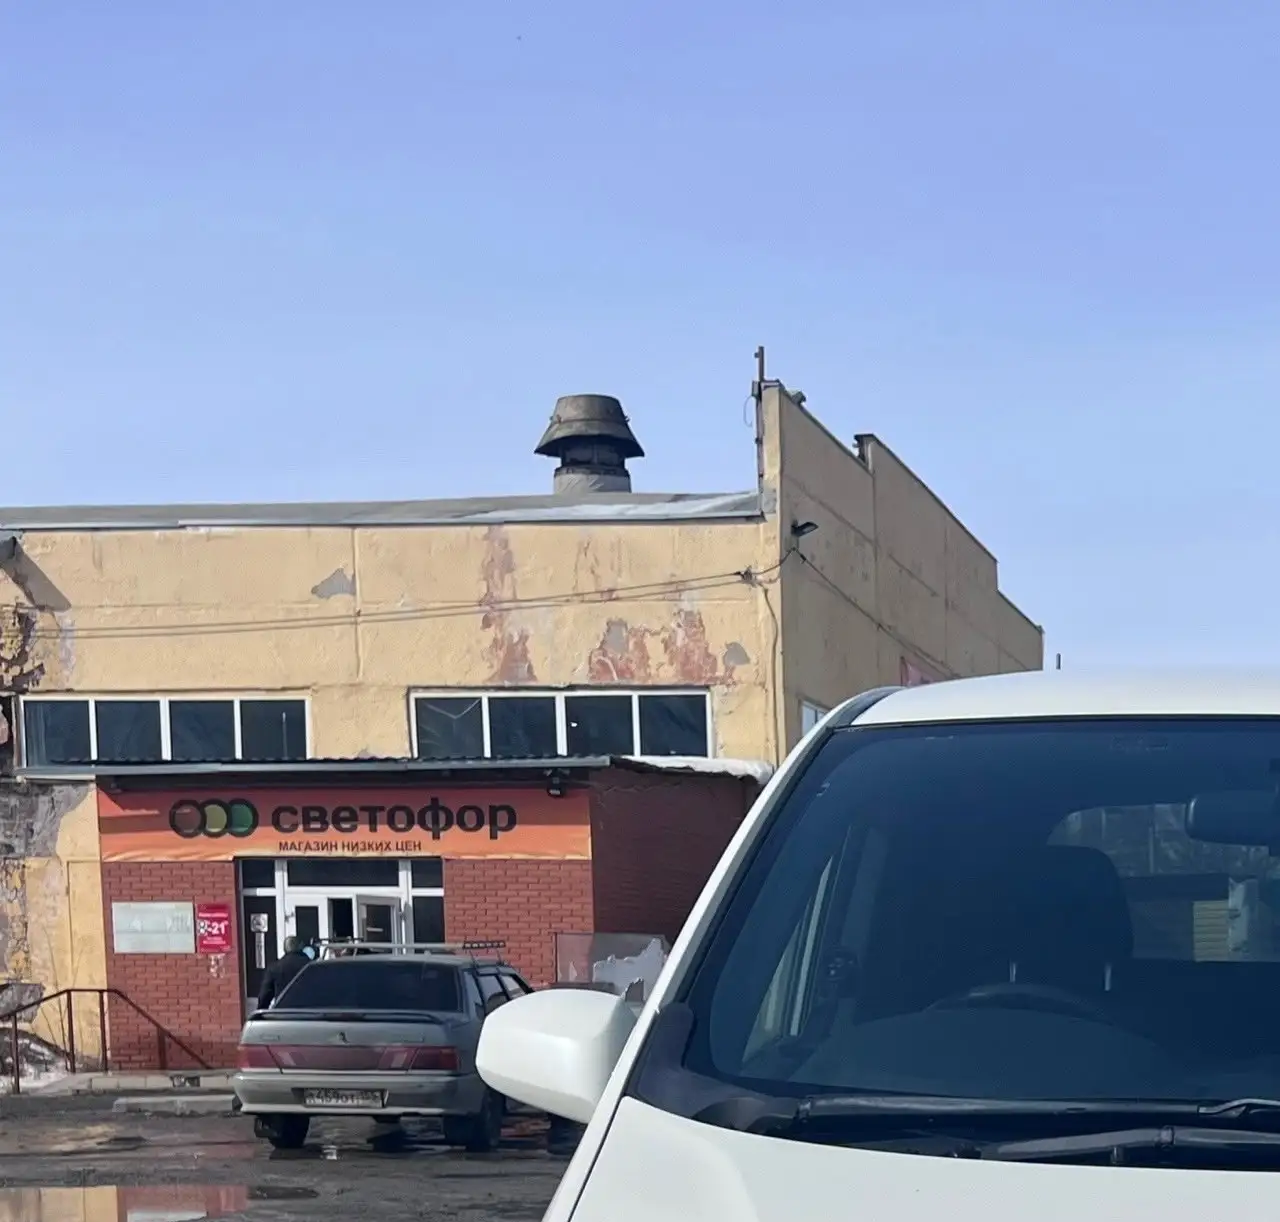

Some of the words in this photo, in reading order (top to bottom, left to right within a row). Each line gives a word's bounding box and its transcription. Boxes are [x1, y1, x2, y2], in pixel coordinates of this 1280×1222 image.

[271, 797, 517, 840] светофор
[278, 841, 338, 852] МАГАЗИН
[341, 841, 392, 852] НИЗКИХ
[395, 841, 422, 853] ЦЕН
